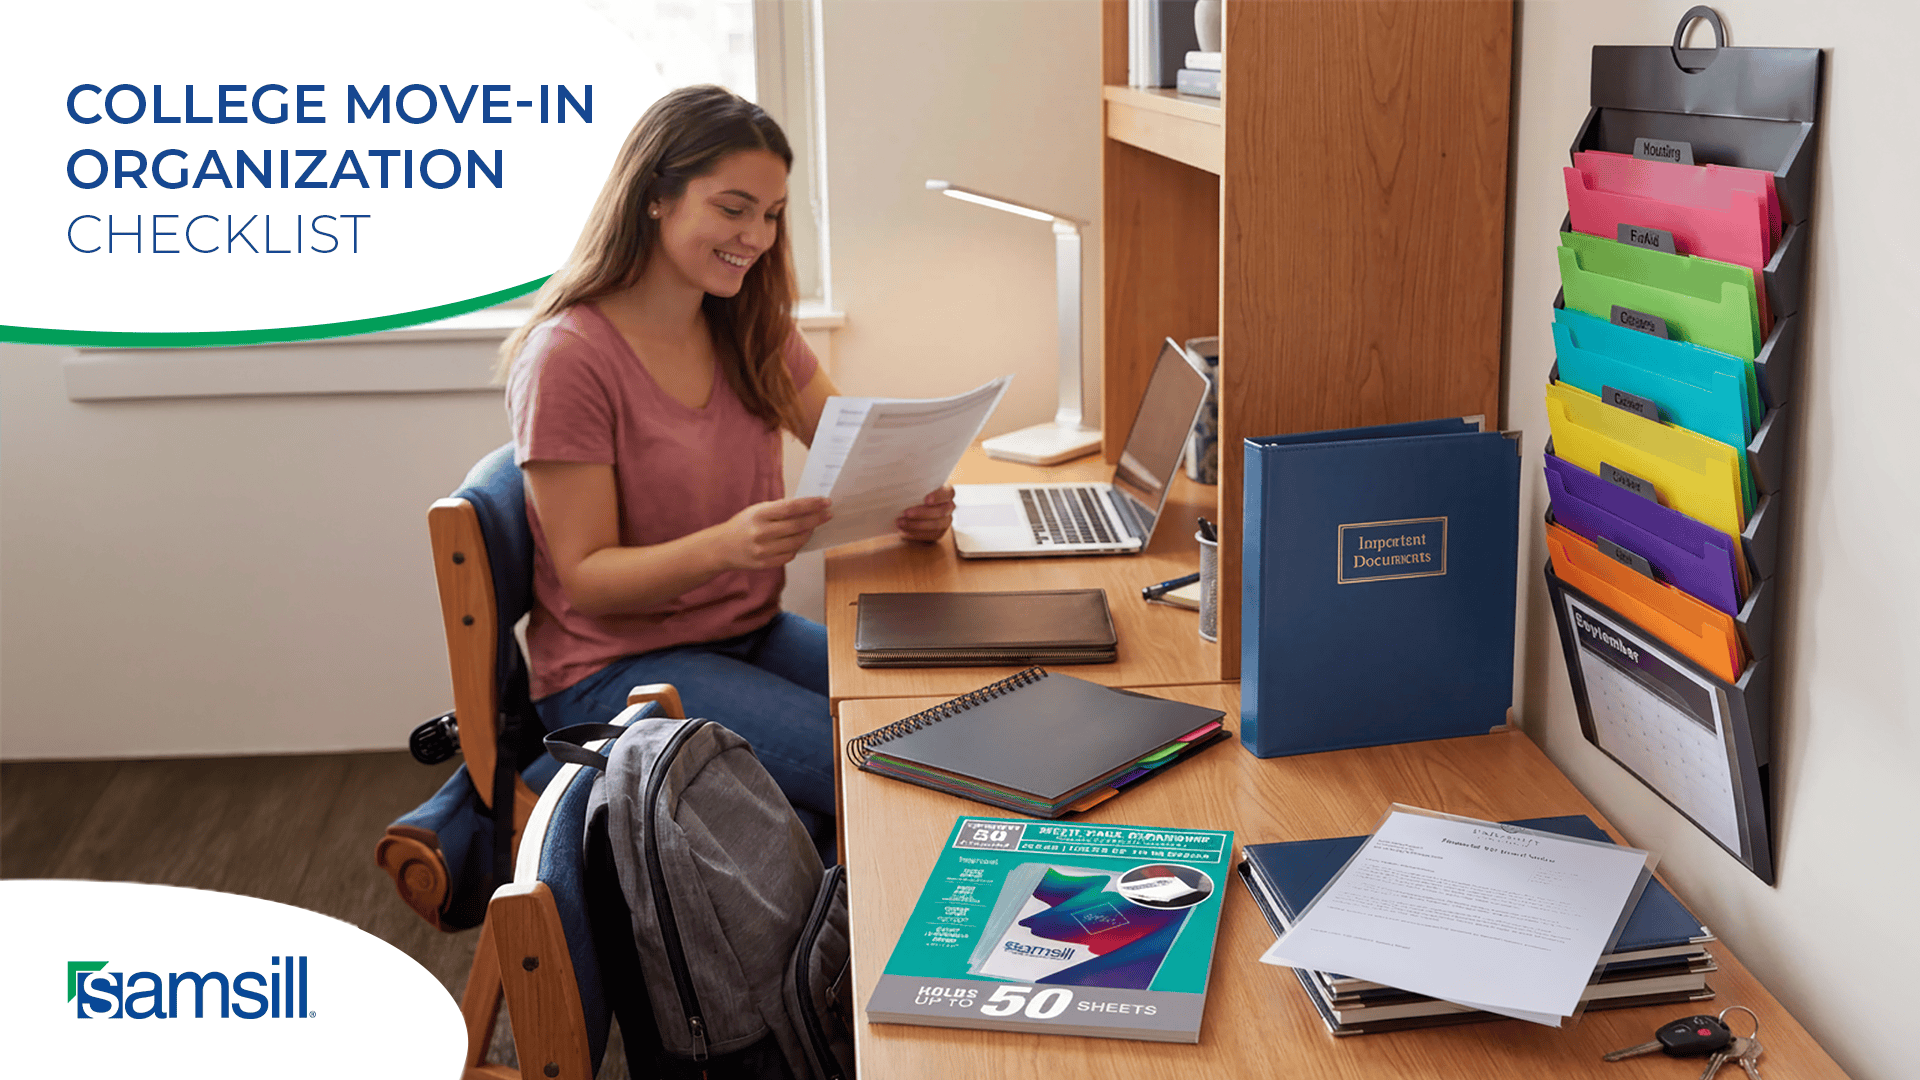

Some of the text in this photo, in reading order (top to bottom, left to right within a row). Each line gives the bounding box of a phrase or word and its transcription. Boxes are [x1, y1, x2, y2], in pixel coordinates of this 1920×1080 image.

[918, 986, 979, 999] HOLDS
[914, 996, 974, 1008] UP TO
[980, 984, 1074, 1019] 50
[1076, 1001, 1157, 1016] SHEETS
